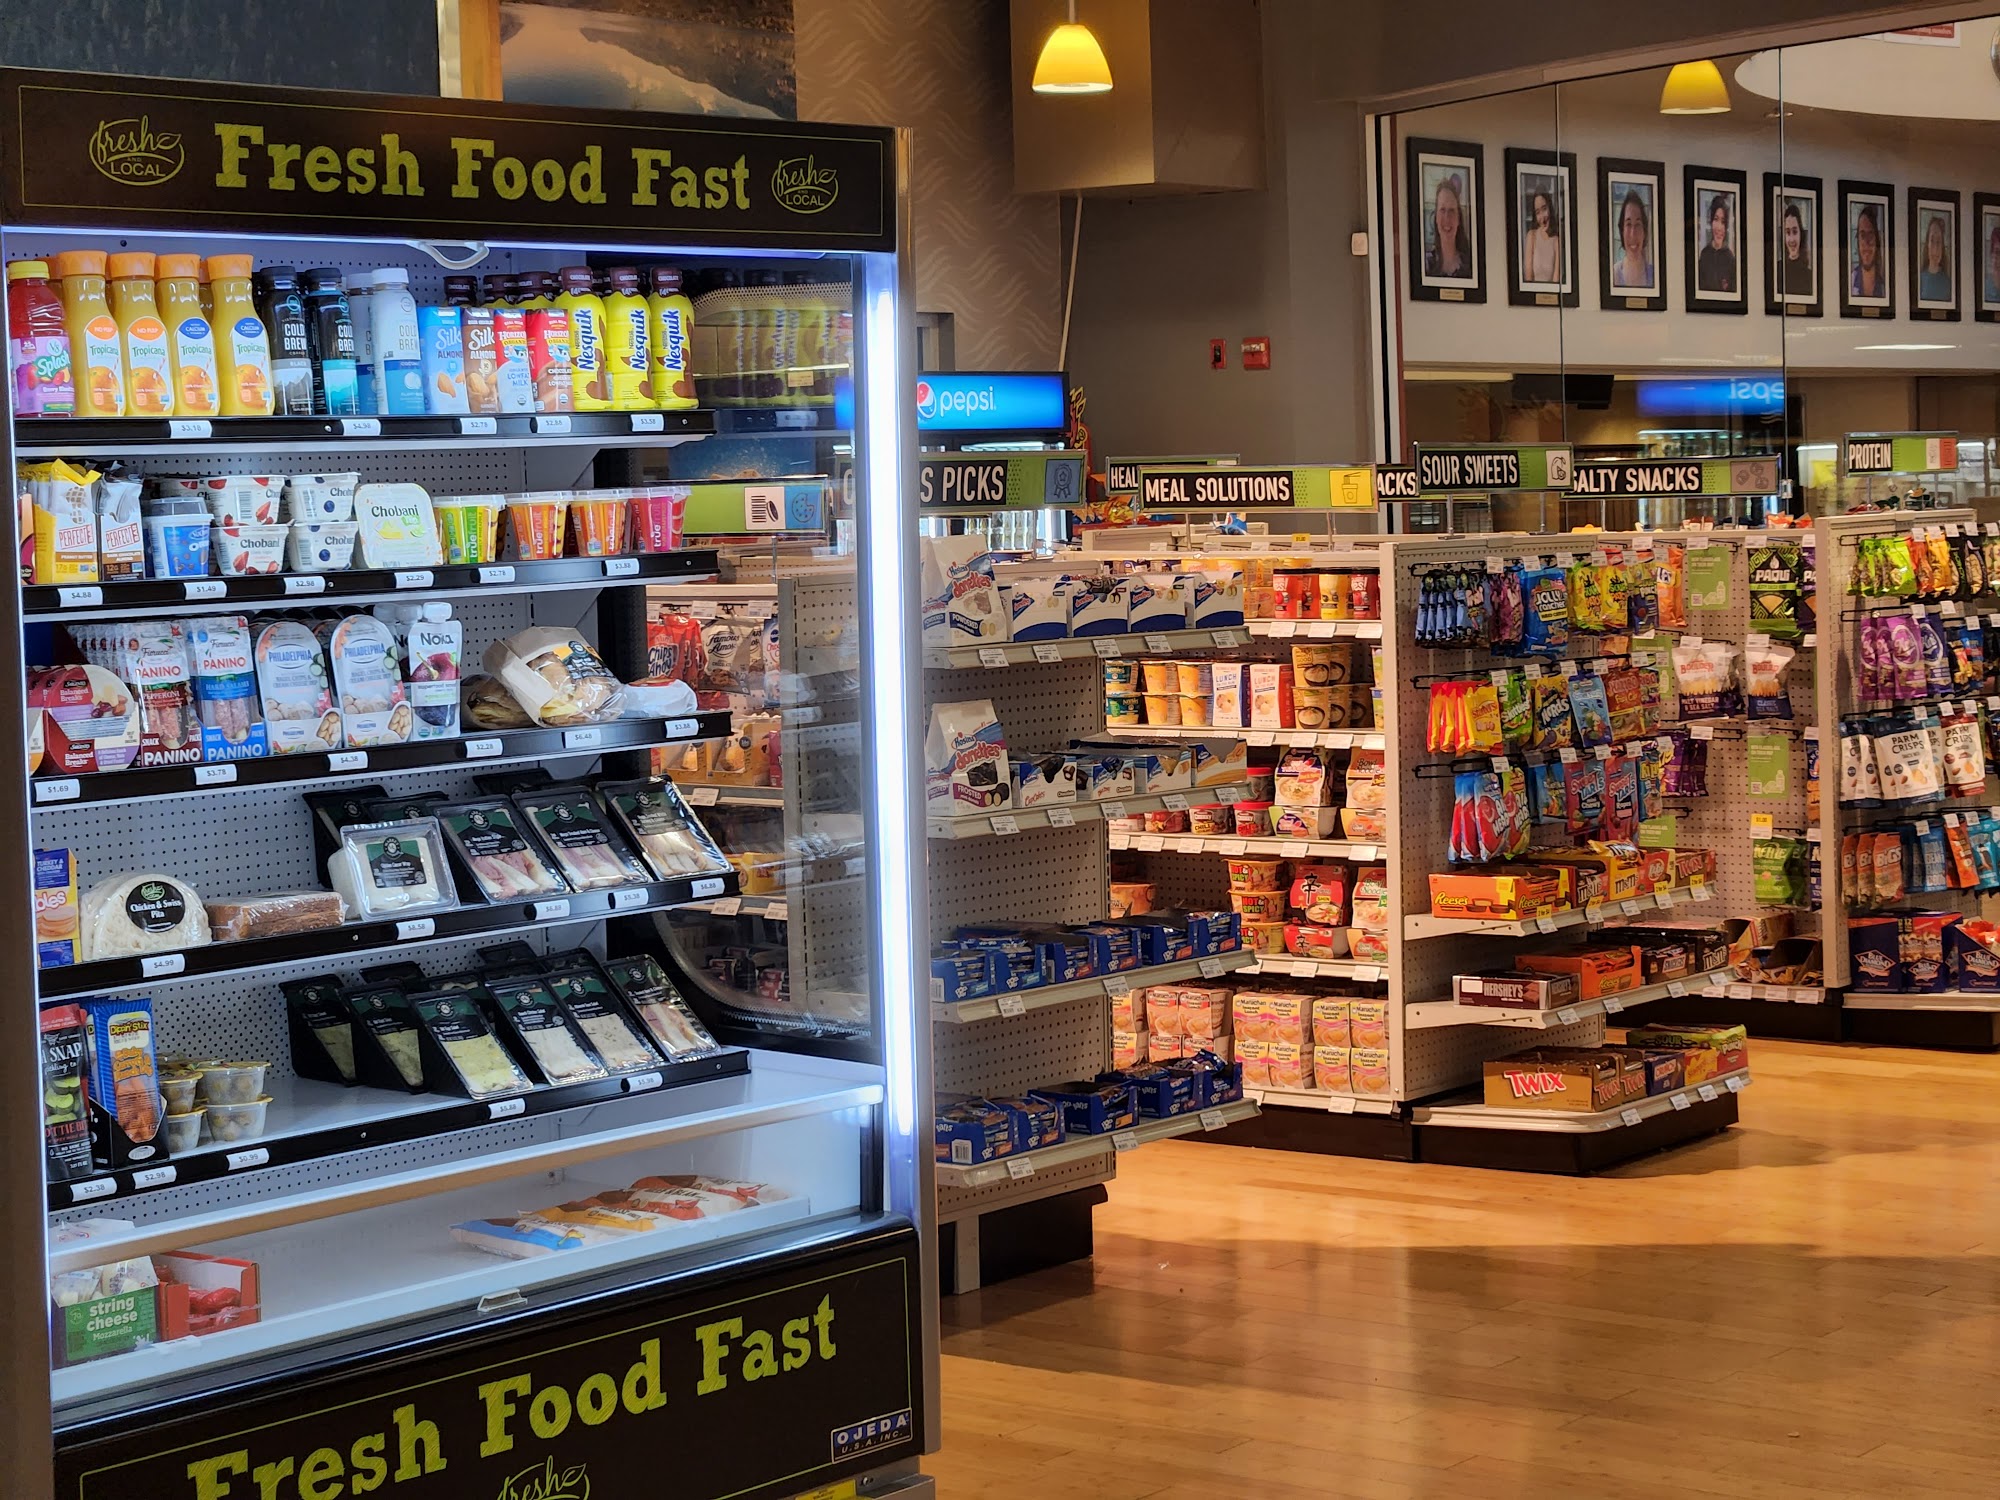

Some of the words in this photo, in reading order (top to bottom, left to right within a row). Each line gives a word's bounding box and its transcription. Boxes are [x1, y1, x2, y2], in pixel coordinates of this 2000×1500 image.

[95, 114, 160, 163] fresh
[111, 161, 166, 177] LOCAL
[214, 123, 425, 196] Fresh
[451, 137, 606, 202] Food
[631, 148, 750, 210] Fast
[775, 154, 822, 190] fresh
[786, 194, 825, 207] LOCAL
[284, 323, 305, 337] COLD
[284, 338, 306, 350] BREW
[436, 327, 461, 349] Silk
[468, 327, 495, 350] Silk
[575, 309, 597, 370] Nesquik
[630, 309, 649, 370] Nesquik
[662, 309, 685, 370] Nesquik
[90, 344, 119, 356] Tropicana
[132, 345, 165, 357] Tropicana
[181, 345, 212, 356] Tropicana
[237, 344, 266, 354] Tropicana
[37, 352, 70, 376] Splash
[940, 386, 995, 417] pepsi
[1849, 442, 1892, 469] PROTEIN
[1422, 454, 1461, 486] SOUR
[1464, 454, 1518, 485] SWEETS
[942, 465, 1005, 502] PICKS
[1625, 466, 1700, 492] SNACKS
[1145, 477, 1191, 503] MEAL
[1196, 475, 1291, 502] SOLUTIONS
[371, 504, 419, 517] Chobani
[59, 525, 88, 549] PERFECT
[105, 526, 133, 549] PERFECT
[240, 538, 280, 548] Chobani
[1755, 569, 1790, 582] PAQUI
[196, 585, 217, 593] $1.49
[952, 571, 992, 599] donettes
[1536, 590, 1562, 605] JOLLY
[210, 638, 236, 648] Fiorucci
[420, 632, 454, 646] Noka
[706, 632, 740, 648] Famous
[142, 647, 169, 657] Fiorucci
[344, 643, 386, 658] PHILADELPHIA
[650, 646, 672, 664] Chips
[709, 643, 736, 653] Amos
[268, 649, 312, 662] PHILADELPHIA
[203, 656, 247, 670] PANINO
[1680, 660, 1714, 674] BOULDER
[135, 665, 181, 678] PANINO
[1215, 672, 1237, 682] LUNCH
[1254, 674, 1276, 684] LUNCH
[60, 688, 89, 696] Balanced
[60, 694, 83, 702] Breaks
[143, 690, 180, 700] PEPPERONI
[1945, 726, 1969, 737] PARM
[141, 737, 160, 746] SNACK
[1891, 733, 1920, 745] PARM
[207, 743, 264, 761] PANINO
[1891, 741, 1925, 755] CRISPS
[64, 752, 94, 761] Balanced
[144, 749, 200, 766] PANINO
[955, 741, 1001, 770] donettes
[64, 759, 88, 767] Breaks
[207, 769, 227, 777] $3.78
[47, 785, 69, 793] $1.69
[957, 785, 982, 800] FROSTED
[1434, 891, 1468, 906] Reese's
[130, 901, 156, 913] Chicken
[156, 900, 162, 910] &
[163, 899, 182, 910] Swiss
[151, 910, 165, 919] Pita
[153, 959, 174, 968] $4.99
[1483, 981, 1524, 998] HERSHEY'S
[1241, 998, 1267, 1007] Maruchan
[1321, 1005, 1347, 1013] Maruchan
[131, 1020, 150, 1032] Stix
[1503, 1069, 1567, 1098] TWIX
[238, 1153, 259, 1162] $0.99
[144, 1171, 166, 1181] $2.98
[83, 1184, 106, 1193] $2.38
[89, 1296, 135, 1318] string
[86, 1310, 138, 1332] cheese
[93, 1325, 133, 1341] Mozzarella
[187, 1403, 447, 1500] Fresh
[479, 1338, 667, 1458] Food
[696, 1293, 837, 1397] Fast
[836, 1411, 908, 1446] OJEDA
